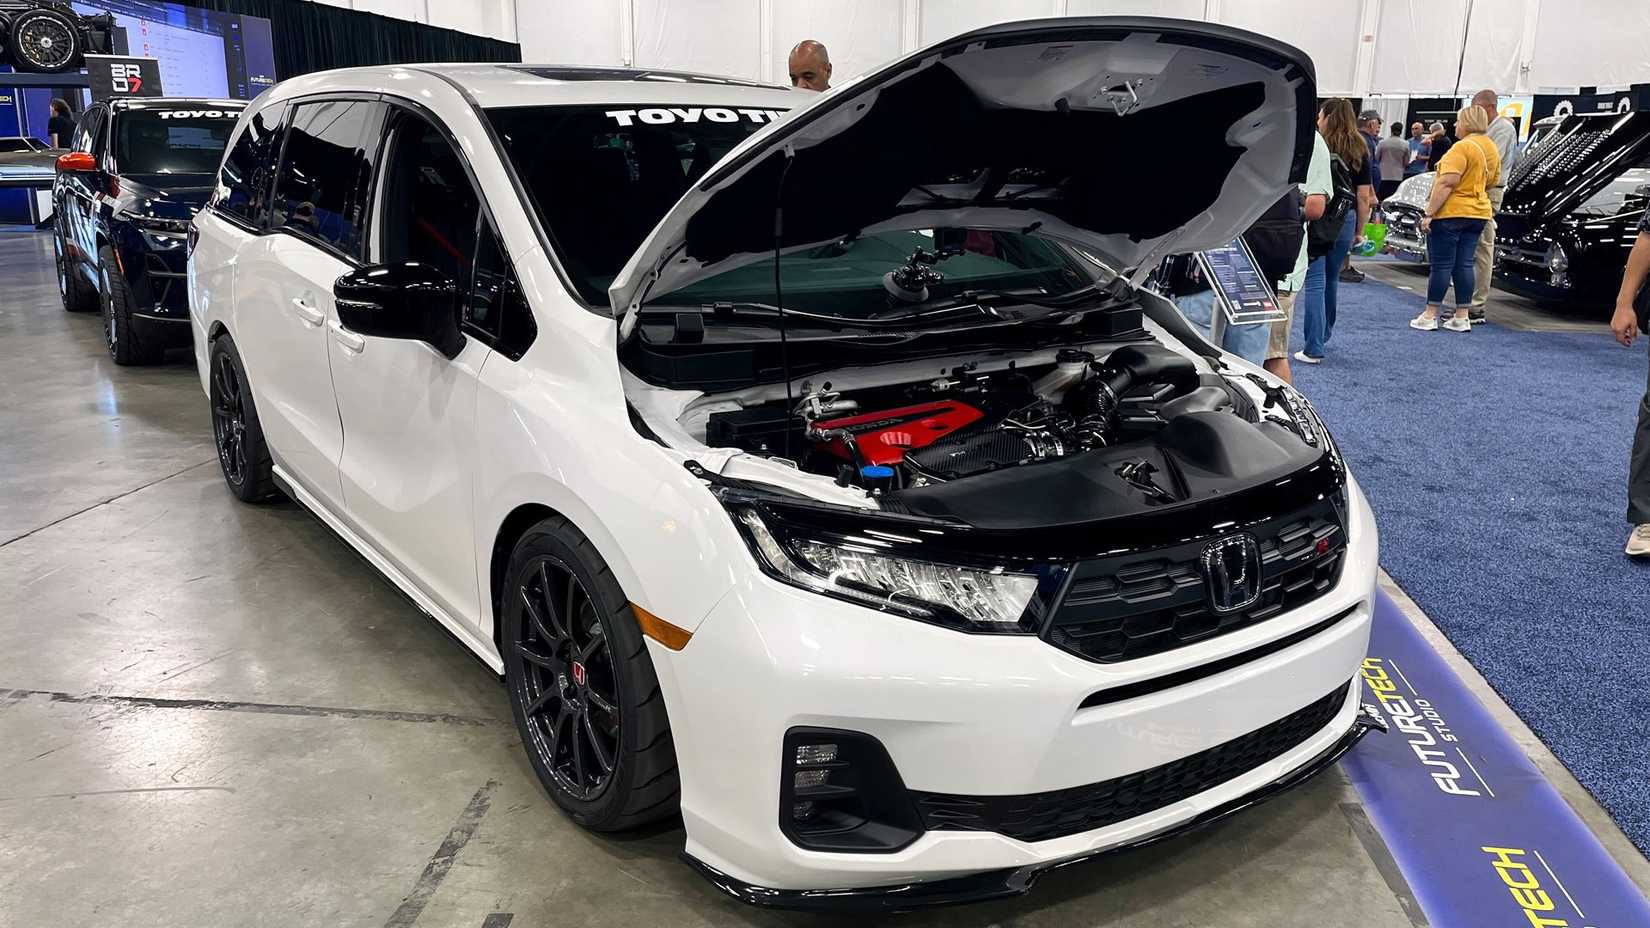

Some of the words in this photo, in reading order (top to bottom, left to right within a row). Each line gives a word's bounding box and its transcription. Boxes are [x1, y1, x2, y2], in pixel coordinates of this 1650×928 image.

[159, 110, 223, 119] TOYO
[605, 108, 740, 126] TOYO
[1414, 699, 1458, 742] STUDIO
